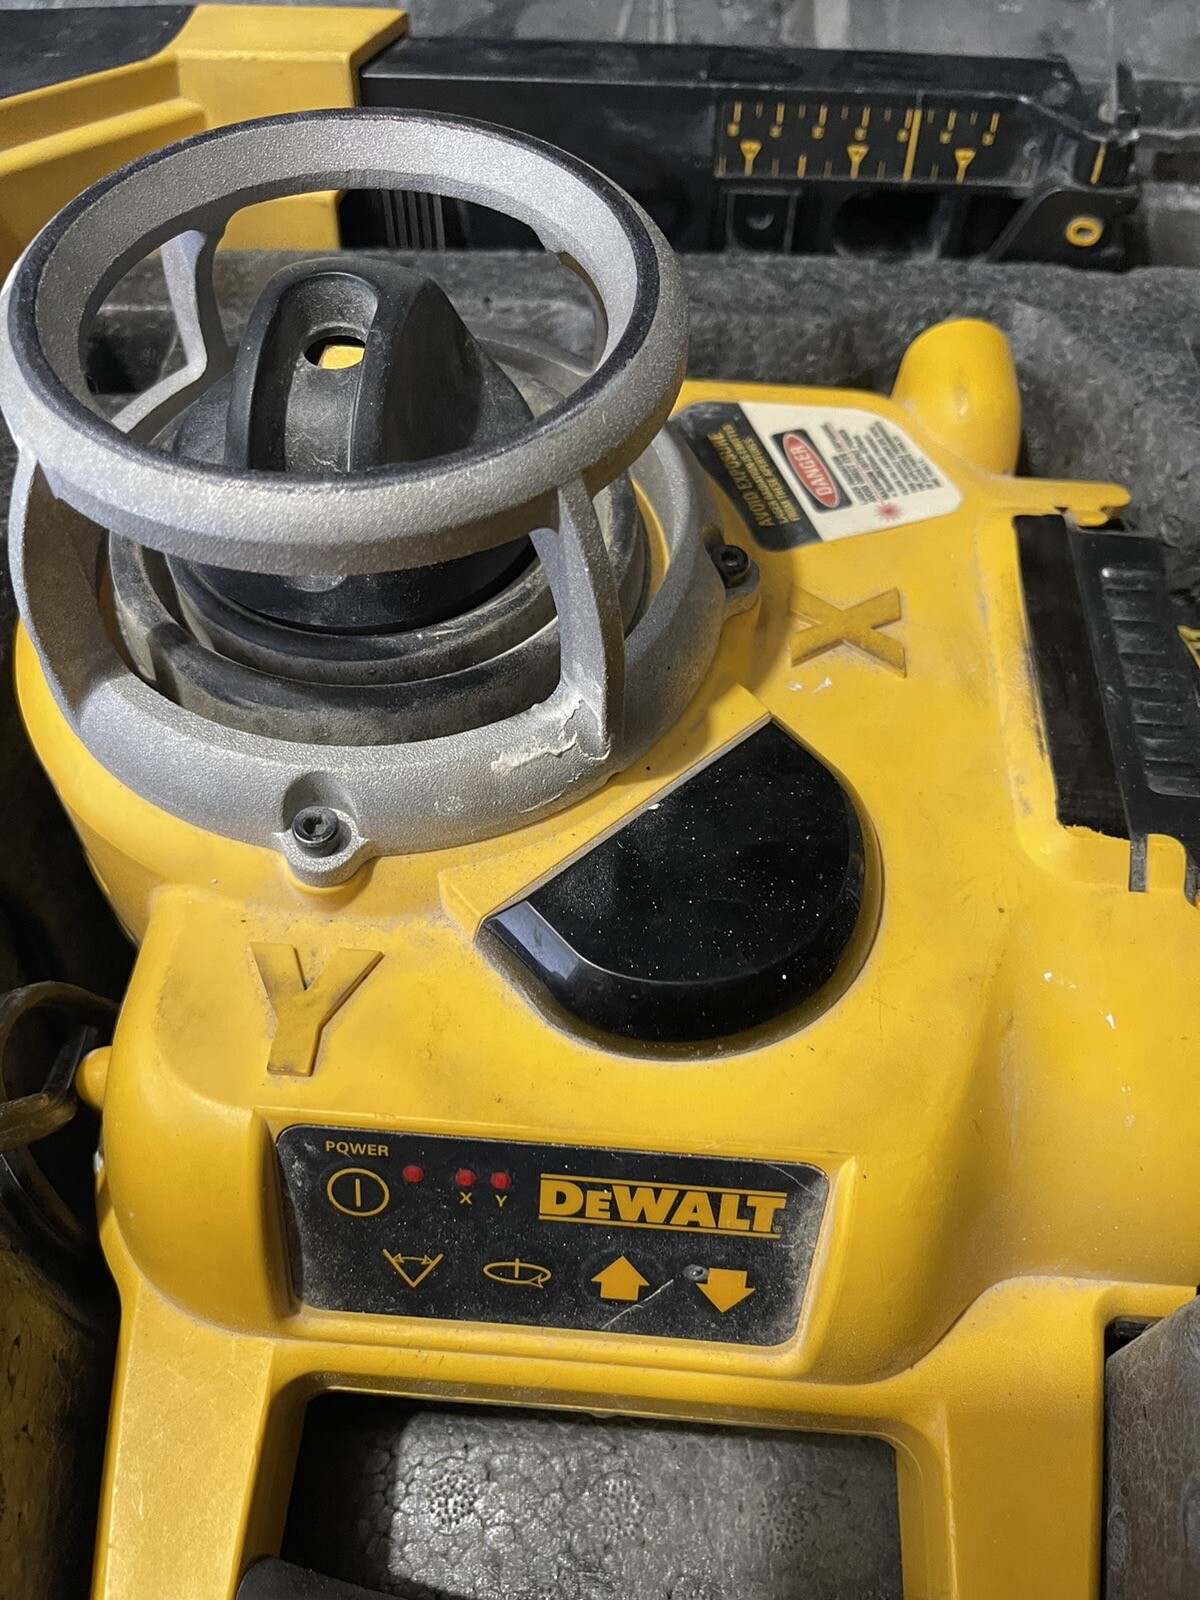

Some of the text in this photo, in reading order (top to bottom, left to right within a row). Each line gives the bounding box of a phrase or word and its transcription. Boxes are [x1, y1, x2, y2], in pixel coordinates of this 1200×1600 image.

[707, 432, 775, 526] AVOID EXPOSURE
[790, 446, 833, 497] DANGER
[789, 584, 907, 678] X
[250, 941, 385, 1077] Y
[325, 1140, 389, 1156] POWER
[459, 1192, 472, 1205] X
[495, 1194, 508, 1208] Y
